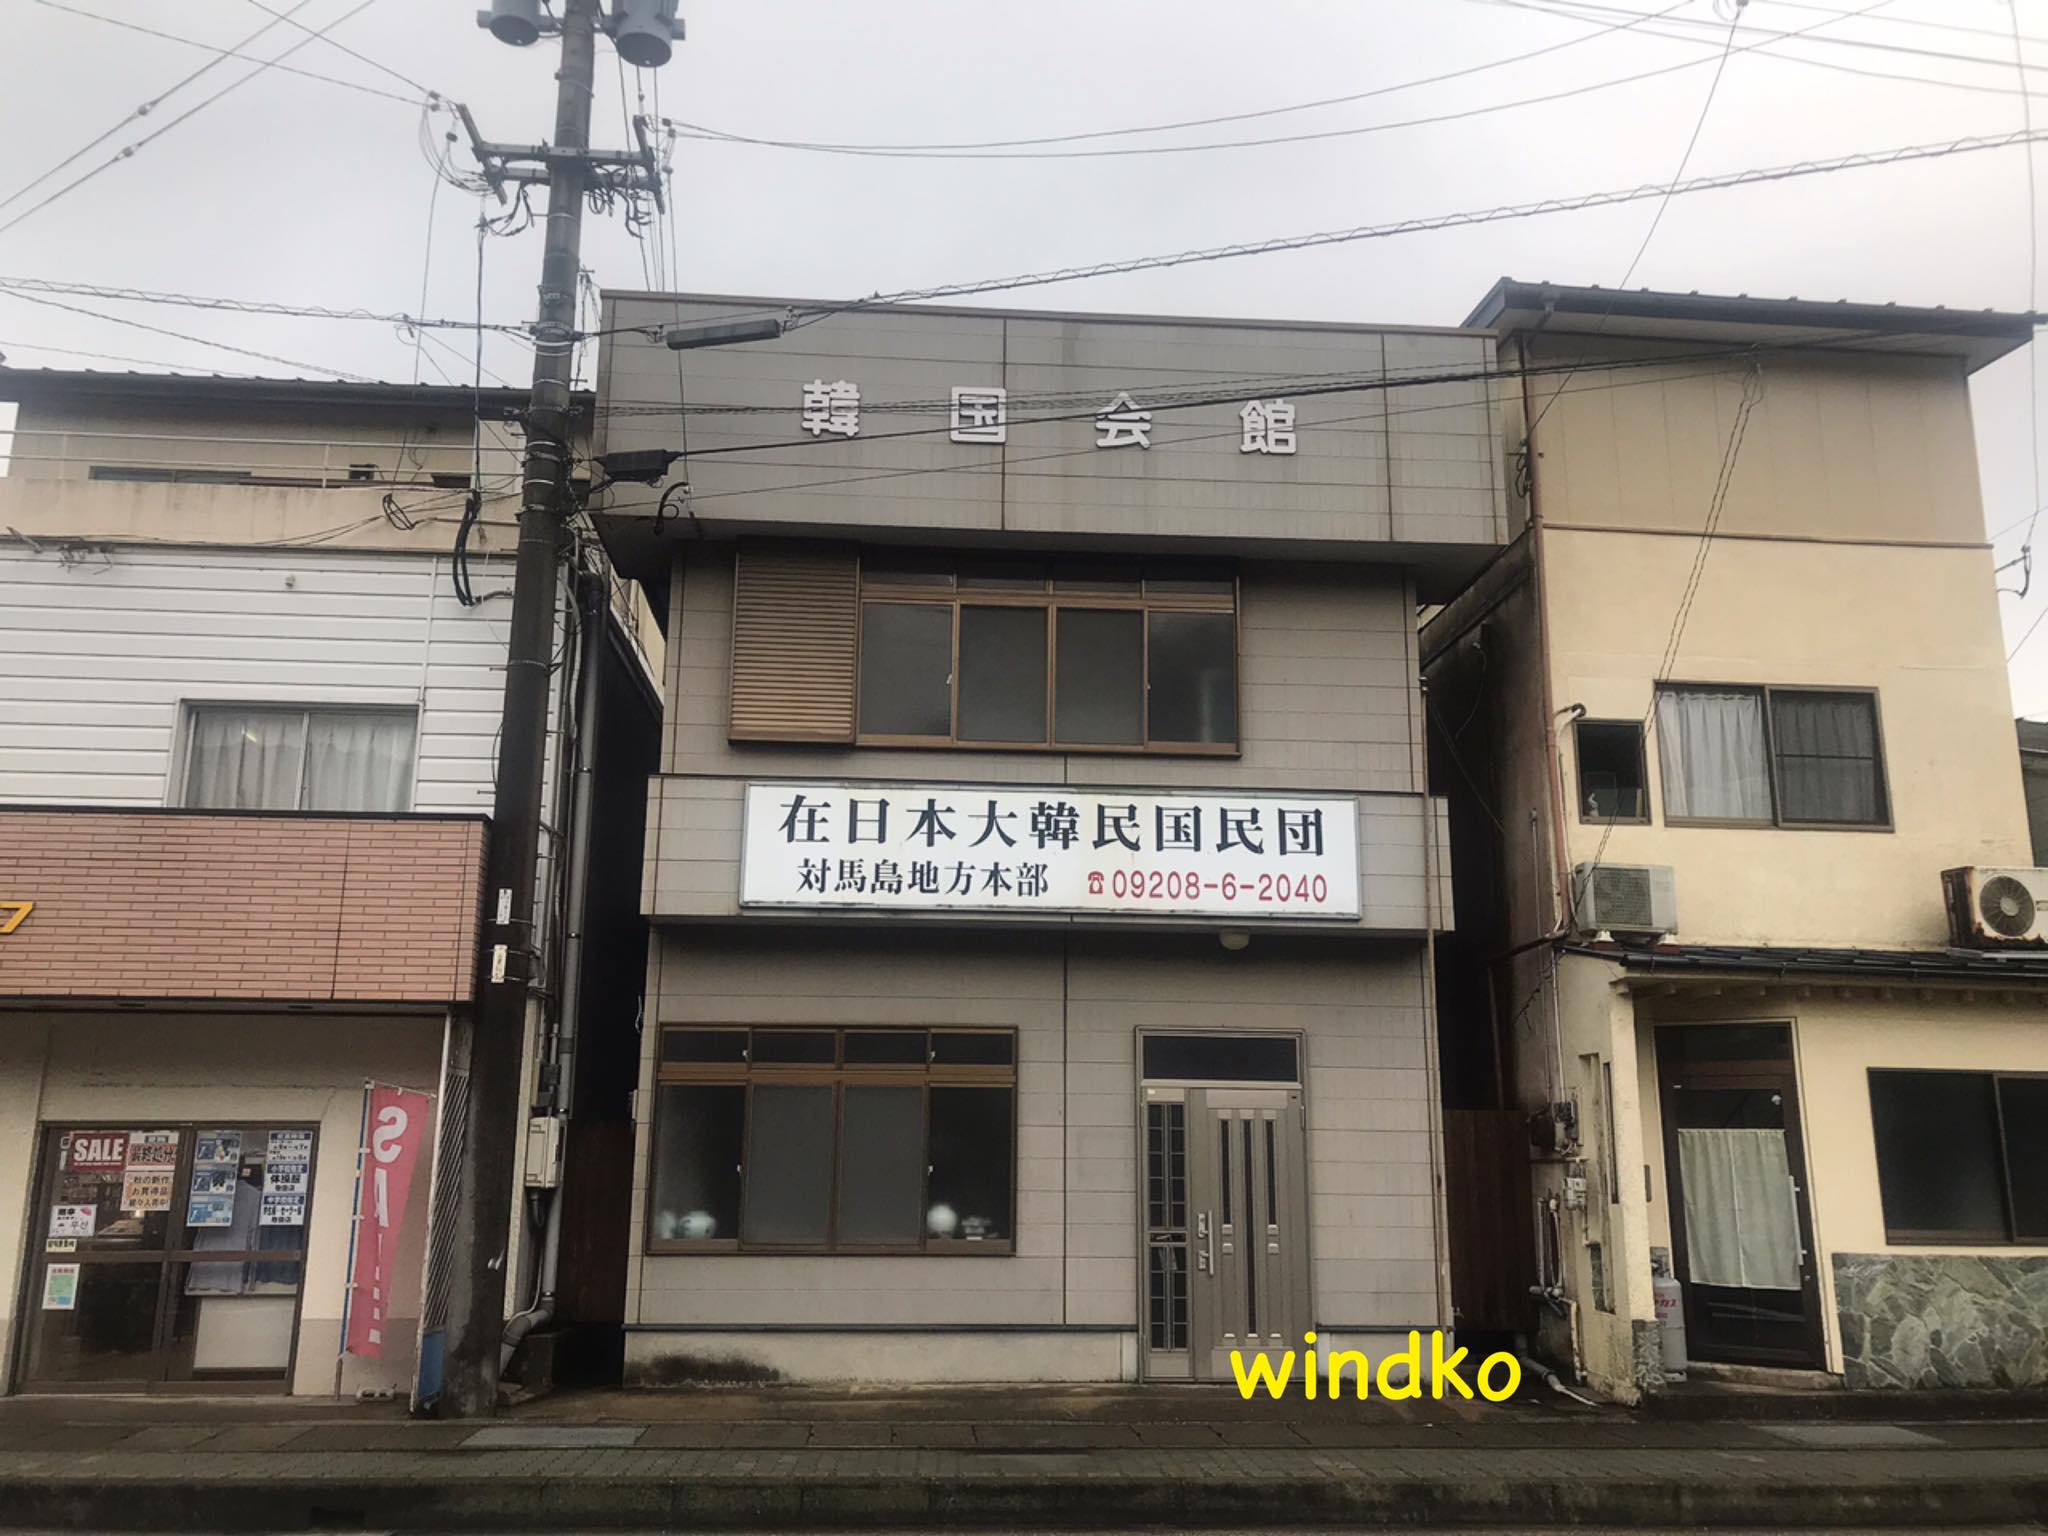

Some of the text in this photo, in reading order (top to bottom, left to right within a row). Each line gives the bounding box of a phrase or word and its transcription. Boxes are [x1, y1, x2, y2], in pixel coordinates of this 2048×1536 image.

[801, 379, 1298, 455] 韓国会館
[779, 794, 1324, 856] 在日本大韓民国民団
[796, 858, 1049, 898] 対馬島地方本部
[1112, 868, 1328, 903] 09208-6-2040
[74, 1138, 124, 1162] SALE
